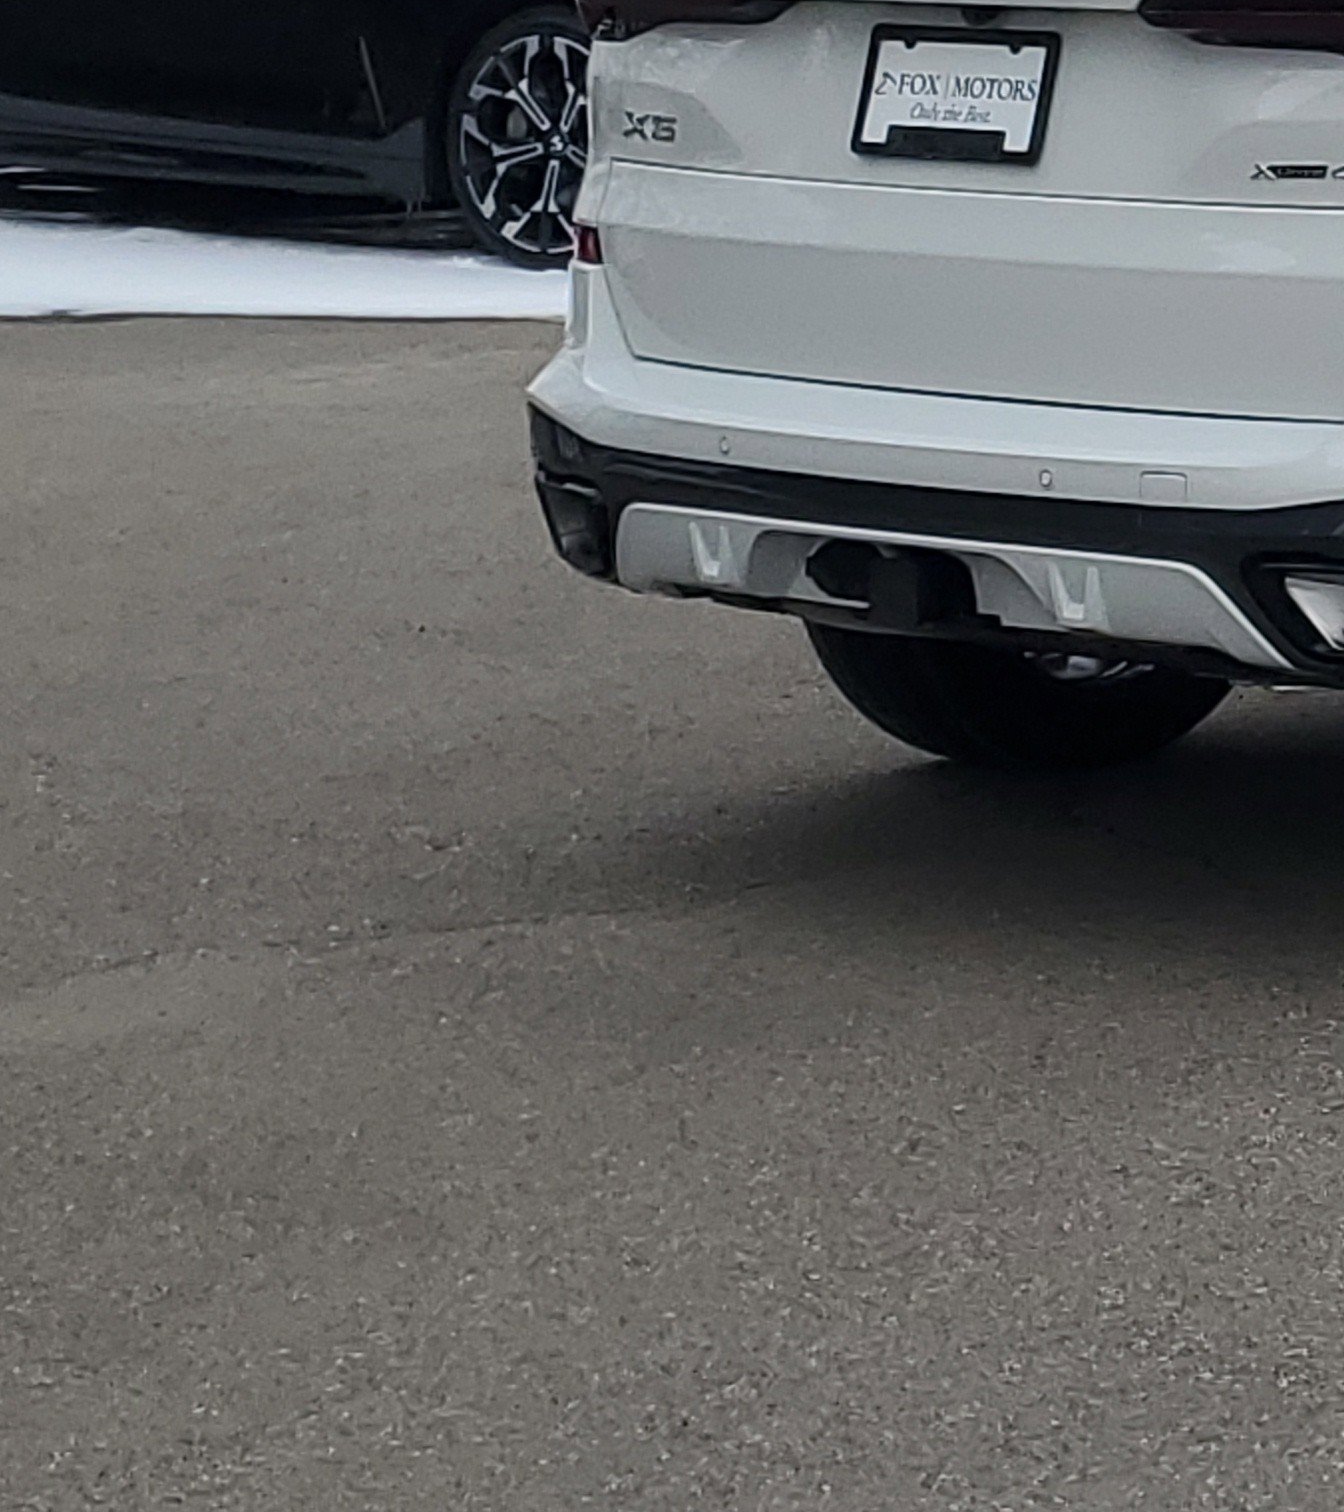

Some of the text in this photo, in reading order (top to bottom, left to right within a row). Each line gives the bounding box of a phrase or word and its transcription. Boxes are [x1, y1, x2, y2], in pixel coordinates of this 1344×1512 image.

[898, 72, 1038, 102] FOX MOTORS
[622, 110, 677, 143] X5
